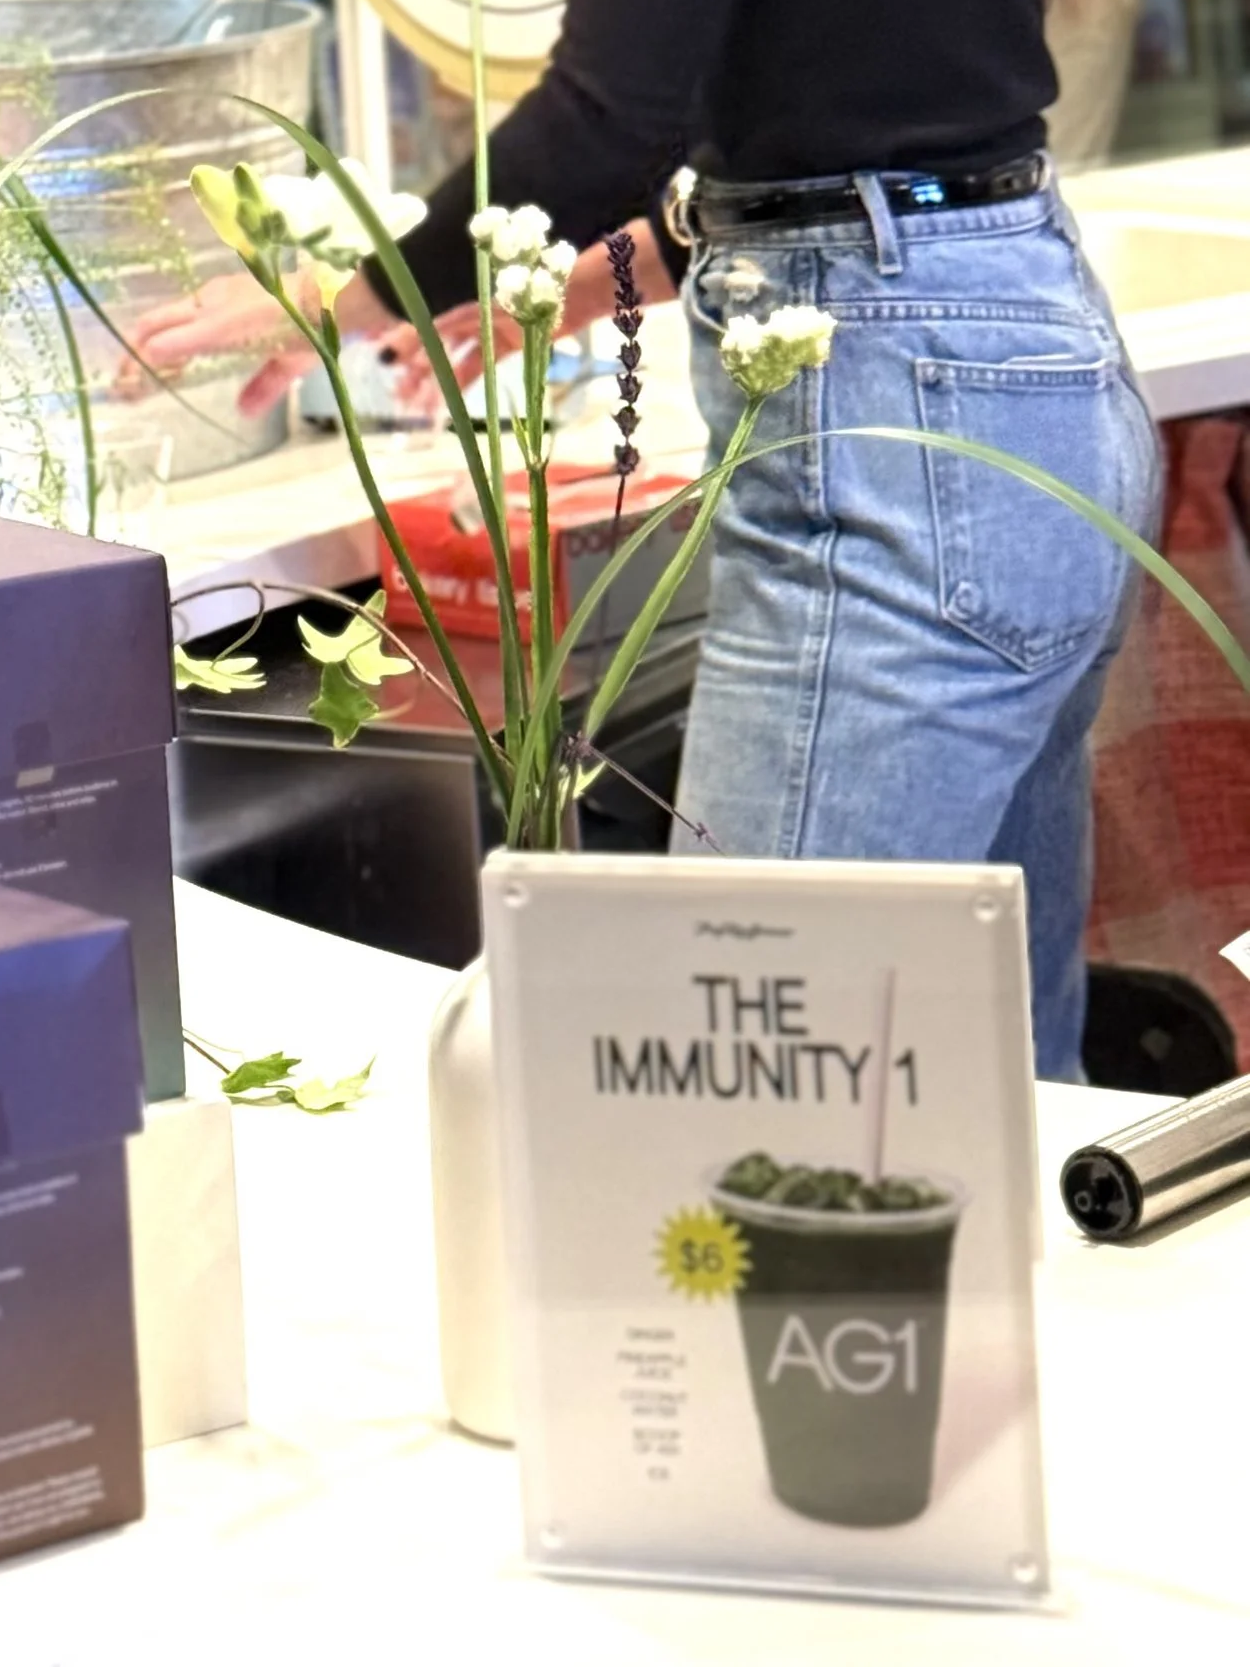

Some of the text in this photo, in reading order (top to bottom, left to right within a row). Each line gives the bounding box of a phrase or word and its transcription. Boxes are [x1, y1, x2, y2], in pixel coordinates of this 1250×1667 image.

[692, 974, 808, 1035] THE
[594, 1035, 916, 1106] IMMUNITY 1
[679, 1238, 724, 1275] $6
[767, 1314, 917, 1394] AG1
